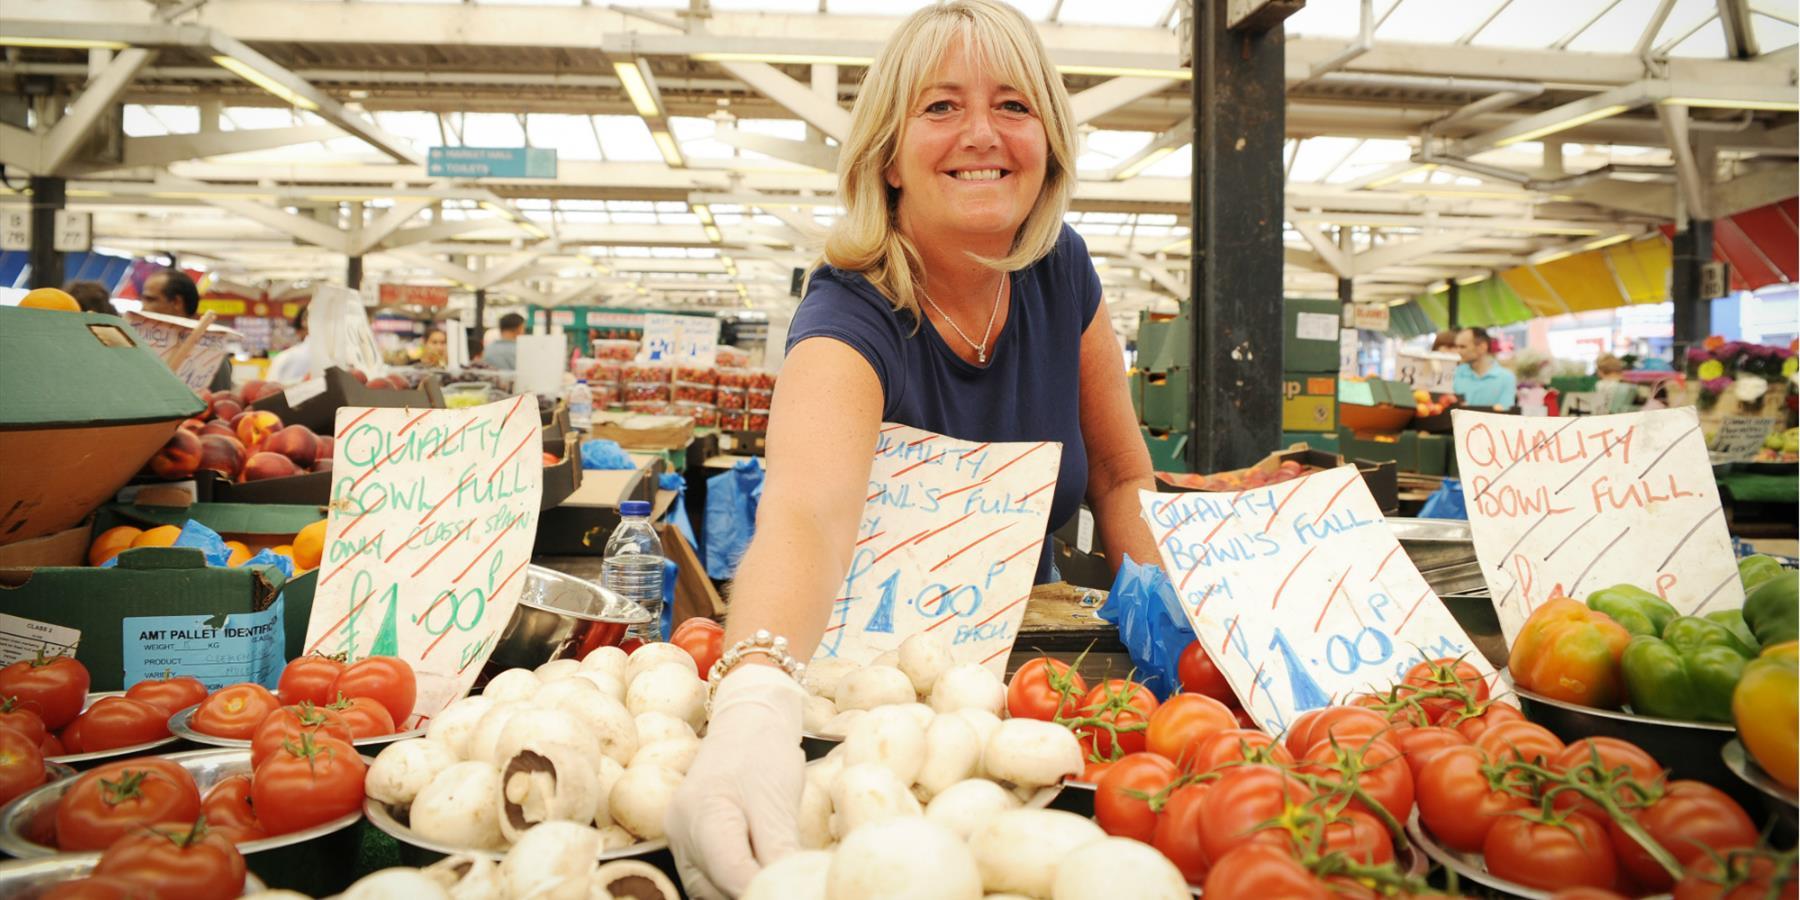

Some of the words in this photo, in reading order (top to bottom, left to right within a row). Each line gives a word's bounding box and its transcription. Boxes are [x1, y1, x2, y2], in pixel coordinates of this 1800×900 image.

[344, 416, 508, 472] QUALITY
[874, 432, 988, 479] UALITY
[1466, 423, 1635, 468] QUALITY
[334, 477, 434, 520] BOWL
[964, 488, 1041, 515] FULL.
[1151, 490, 1278, 531] QUALITY
[1472, 475, 1576, 517] BOWL
[1591, 474, 1704, 513] FULL.
[1293, 509, 1384, 545] FULL.
[139, 630, 167, 641] AMT
[170, 628, 216, 640] PALLET
[144, 643, 175, 651] WEIGHT
